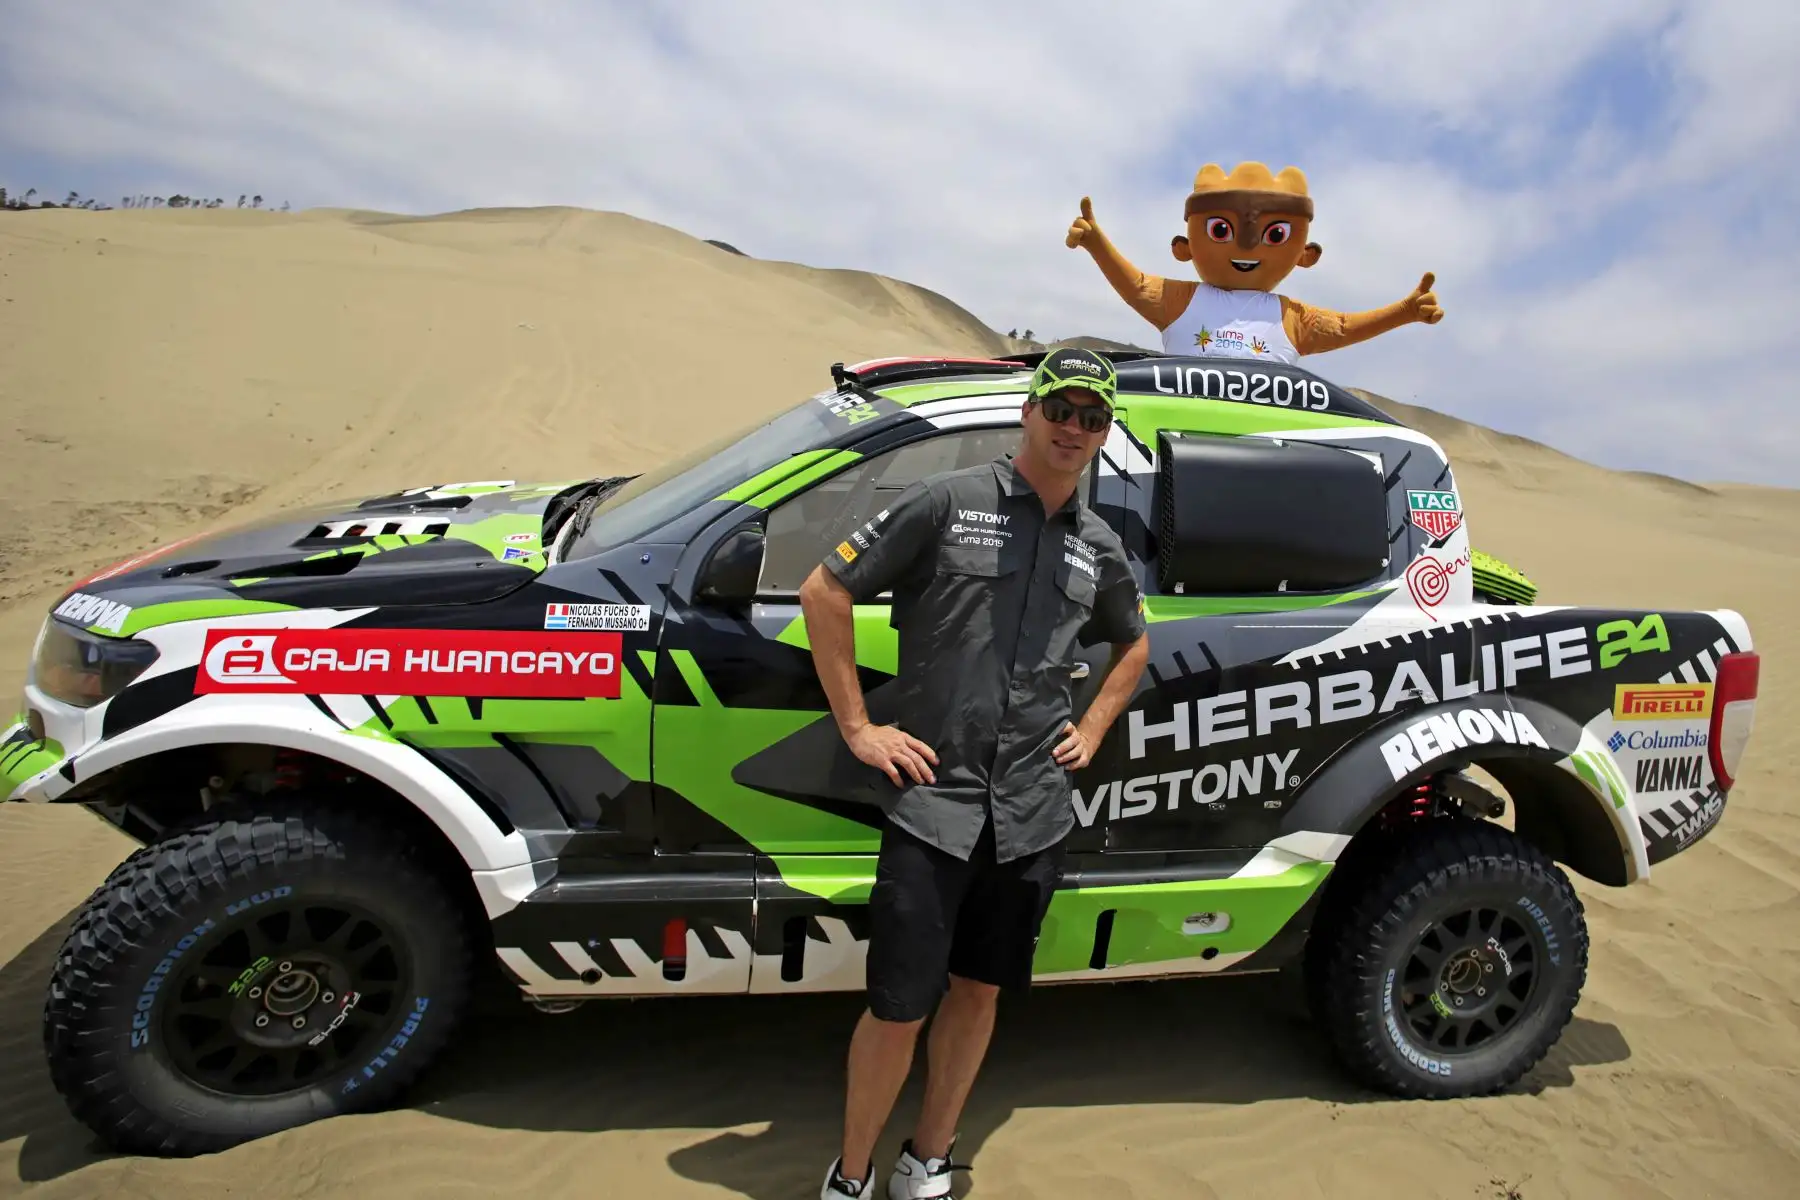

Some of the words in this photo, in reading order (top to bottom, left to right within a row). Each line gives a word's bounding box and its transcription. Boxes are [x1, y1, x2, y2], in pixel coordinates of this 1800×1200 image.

[1215, 339, 1243, 351] 2019
[1411, 493, 1455, 510] TAG
[958, 509, 1011, 526] VISTONY
[1412, 511, 1460, 536] HEUER
[982, 537, 1004, 548] 2019
[1063, 540, 1096, 562] NUTRITION
[1064, 532, 1098, 556] HERBALIFE
[1064, 552, 1096, 578] RENOVA
[53, 592, 133, 634] RENOVA
[567, 617, 604, 628] FERNANDO
[604, 617, 638, 629] MUSSANO
[638, 618, 648, 628] O+
[569, 605, 602, 616] NICOLAS
[604, 605, 629, 616] FUCHS
[630, 606, 641, 617] O+
[283, 647, 390, 673] CAJA
[404, 648, 614, 676] HUANCAYO
[1128, 627, 1594, 760] HERBALIFE
[1596, 613, 1671, 669] 24
[1622, 690, 1706, 714] PIRELLI
[1379, 708, 1549, 782] RENOVA
[1626, 729, 1708, 750] Columbia
[1635, 755, 1704, 793] VANNA
[1517, 895, 1560, 949] PIRELLI
[130, 917, 217, 1048] SCORPION
[225, 885, 293, 916] MUD
[1487, 936, 1513, 976] FUCHS
[308, 992, 361, 1046] FUCHS
[362, 996, 430, 1079] PIRELLI
[1385, 1015, 1452, 1077] SCORPION
